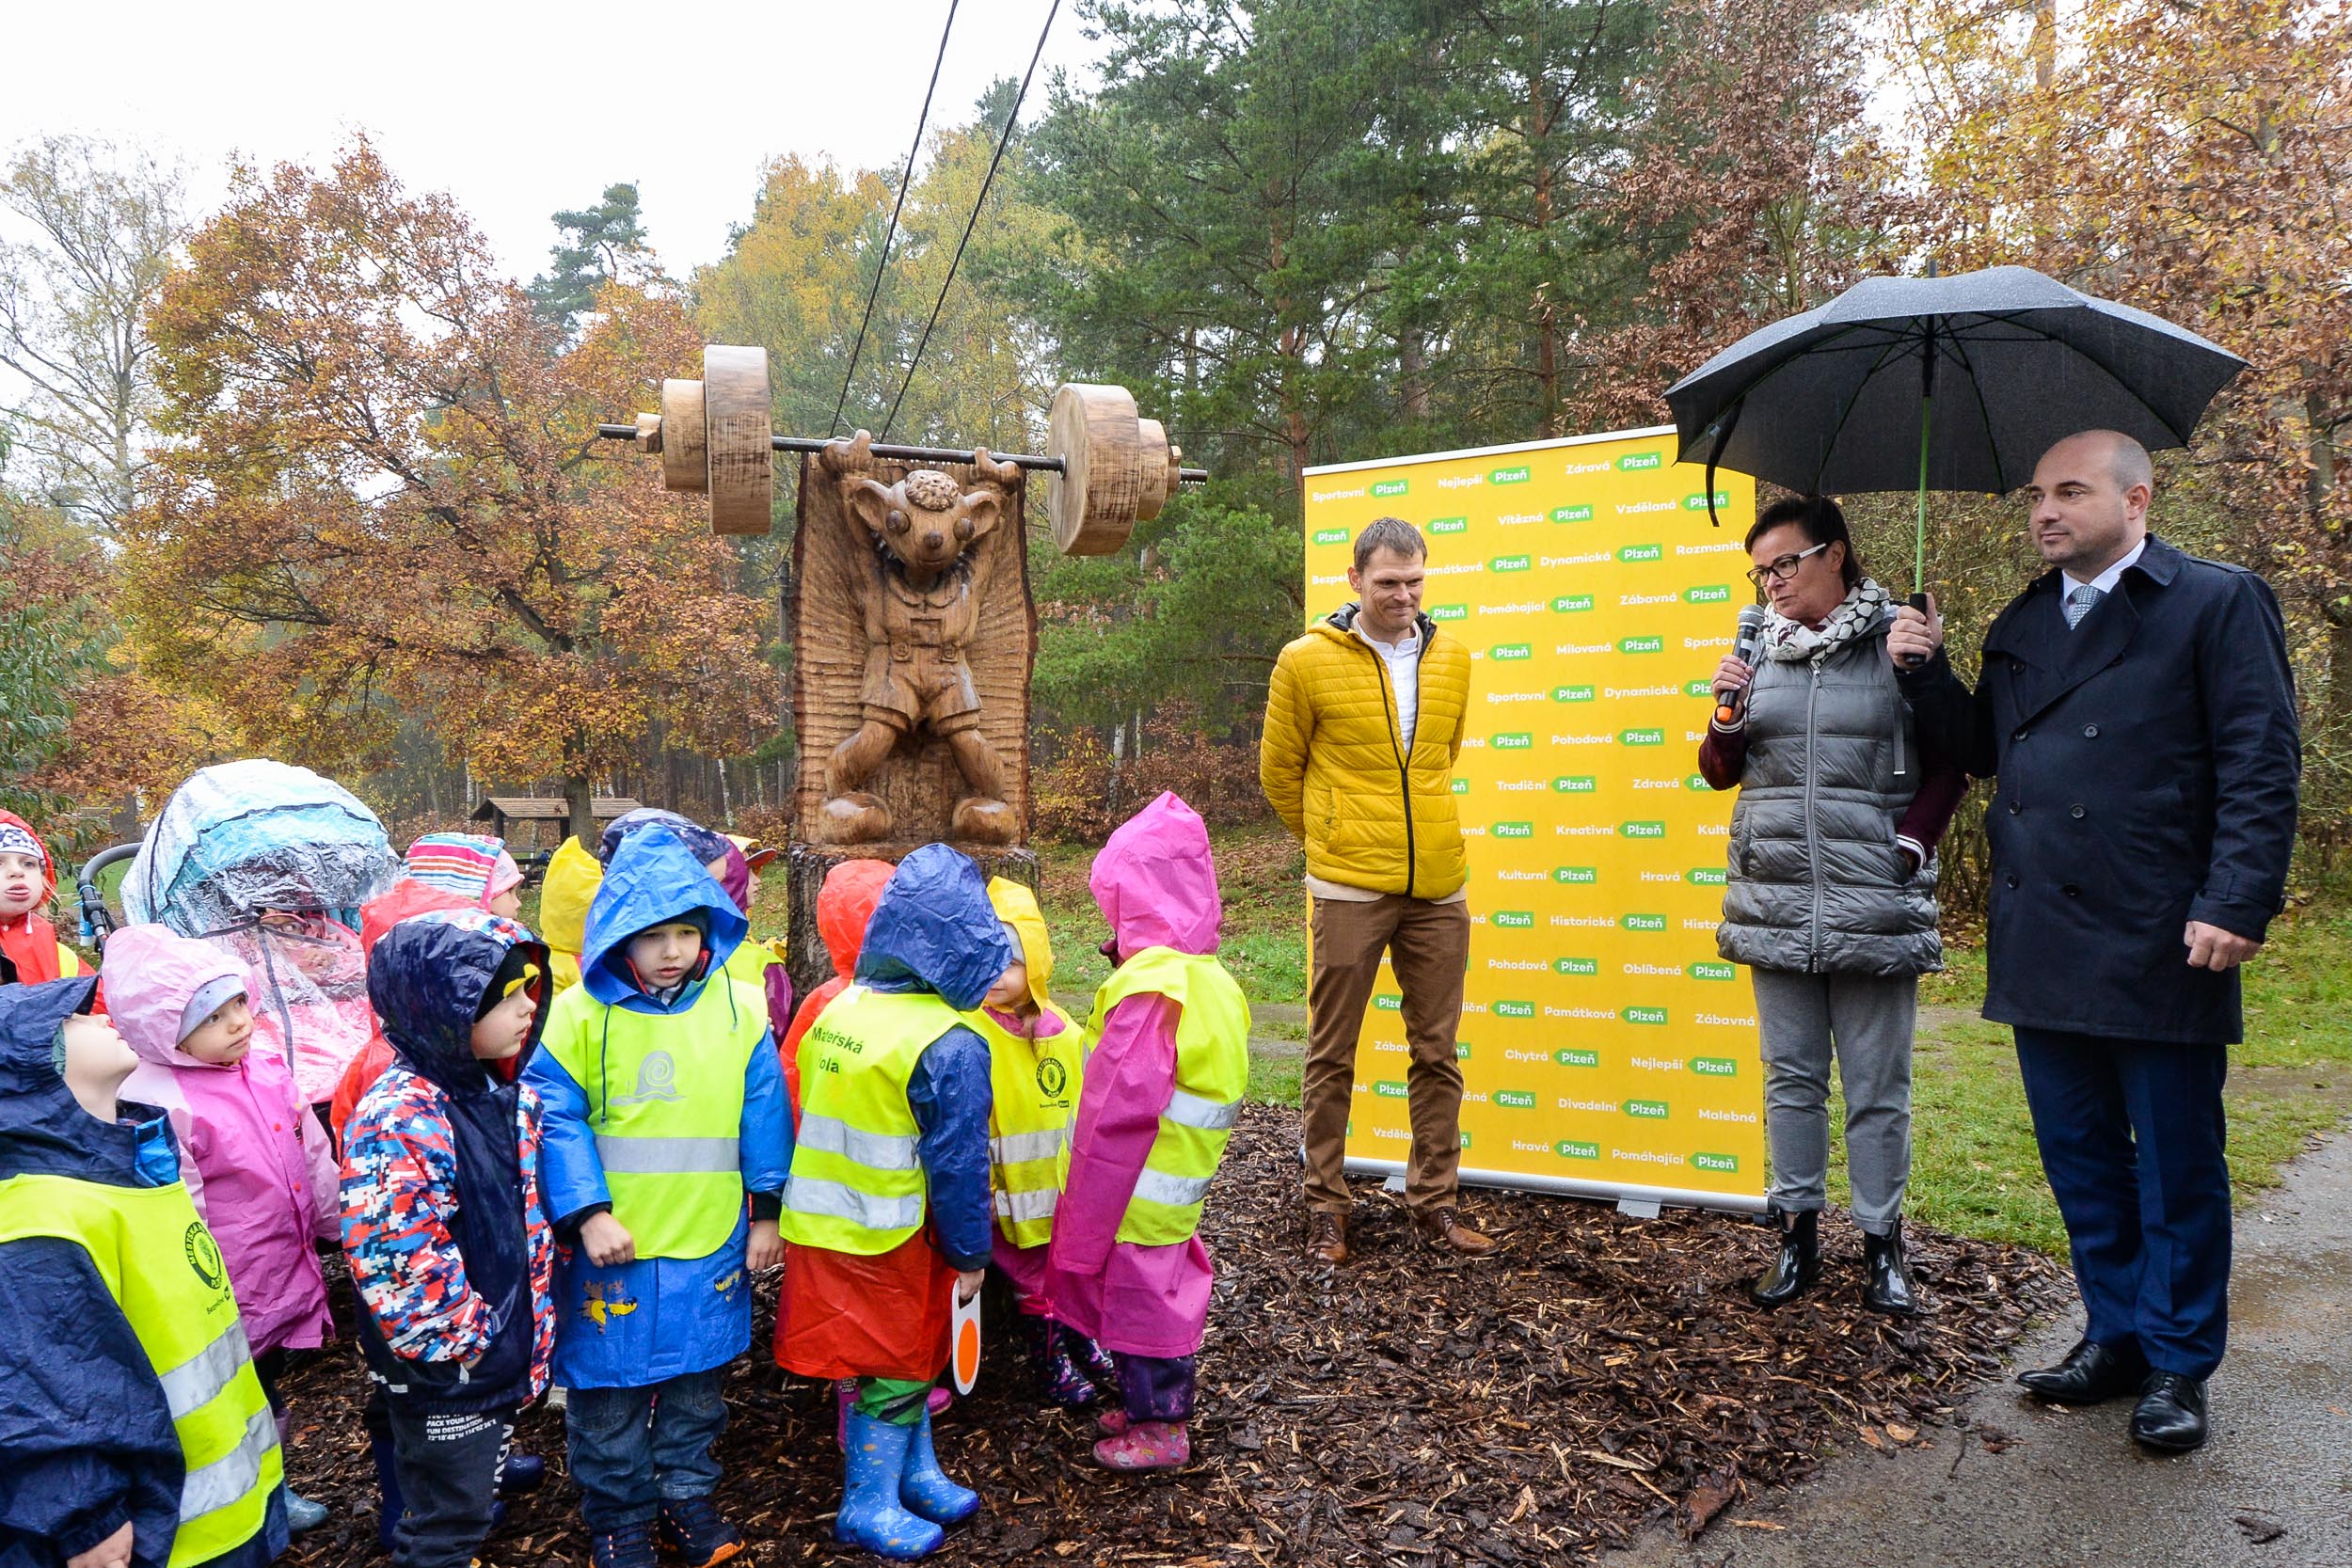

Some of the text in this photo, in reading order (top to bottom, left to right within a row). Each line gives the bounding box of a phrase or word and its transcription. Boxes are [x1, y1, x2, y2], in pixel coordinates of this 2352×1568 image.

[1565, 454, 1659, 475] Zdravá Plzeň
[1438, 468, 1528, 490] Nejlepší Plzeň
[1311, 482, 1406, 503] Sportovní Plzeň
[1615, 494, 1726, 515] Vzdělaná Plzň
[1497, 507, 1590, 526] Vítězná Plzeň
[1432, 519, 1465, 532] Plzeň
[1317, 531, 1347, 543] Plzeň
[1539, 546, 1660, 568] Dynamická Plzeň
[1425, 557, 1528, 577] amátková Plzeň
[1619, 588, 1727, 606] Zábavná Plzeň
[1433, 606, 1465, 619] Plzeň
[1478, 597, 1591, 615] Pomáhající Plzeň
[1555, 639, 1661, 656] Milovaná Plzeň
[1683, 636, 1736, 650] Sportov
[1496, 646, 1529, 658] Plzeň
[1486, 688, 1592, 705] Sportovní Plzeň
[1604, 684, 1712, 700] Dynamická Plz
[1496, 735, 1530, 747] Plzeň
[1551, 731, 1661, 745] Pohodová Plzeň
[1496, 779, 1593, 791] Tradiční Plzeň
[1632, 778, 1679, 789] Zdravá
[1497, 825, 1530, 835] Plzeň
[1555, 824, 1662, 835] Kreativní Plzeň
[1498, 869, 1594, 881] Kulturní Plzeň
[1640, 871, 1681, 882] Hravá
[1498, 914, 1531, 926] Plzeň
[1549, 915, 1663, 928] Historická Plzeň
[1487, 958, 1595, 973] Pohodová Plzeň
[1623, 963, 1732, 978] Oblíbená Plzeň
[1378, 997, 1401, 1009] Plze
[1499, 1004, 1532, 1016] Plzeň
[1544, 1006, 1664, 1022] Památková Plzeň
[1694, 1013, 1756, 1027] Zábavná
[1374, 1040, 1410, 1053] Zábav
[1504, 1049, 1596, 1065] Chytrá Plzeň
[1630, 1056, 1733, 1073] Nejlepší Plzeň
[1500, 1093, 1533, 1106] Plzeň
[1558, 1098, 1665, 1116] Divadelní Plzeň
[1698, 1108, 1757, 1123] Malebná
[1373, 1128, 1413, 1141] Vzděla
[1512, 1139, 1597, 1157] Hravá Plzeň
[1612, 1148, 1735, 1169] Pomáhající Plzeň
